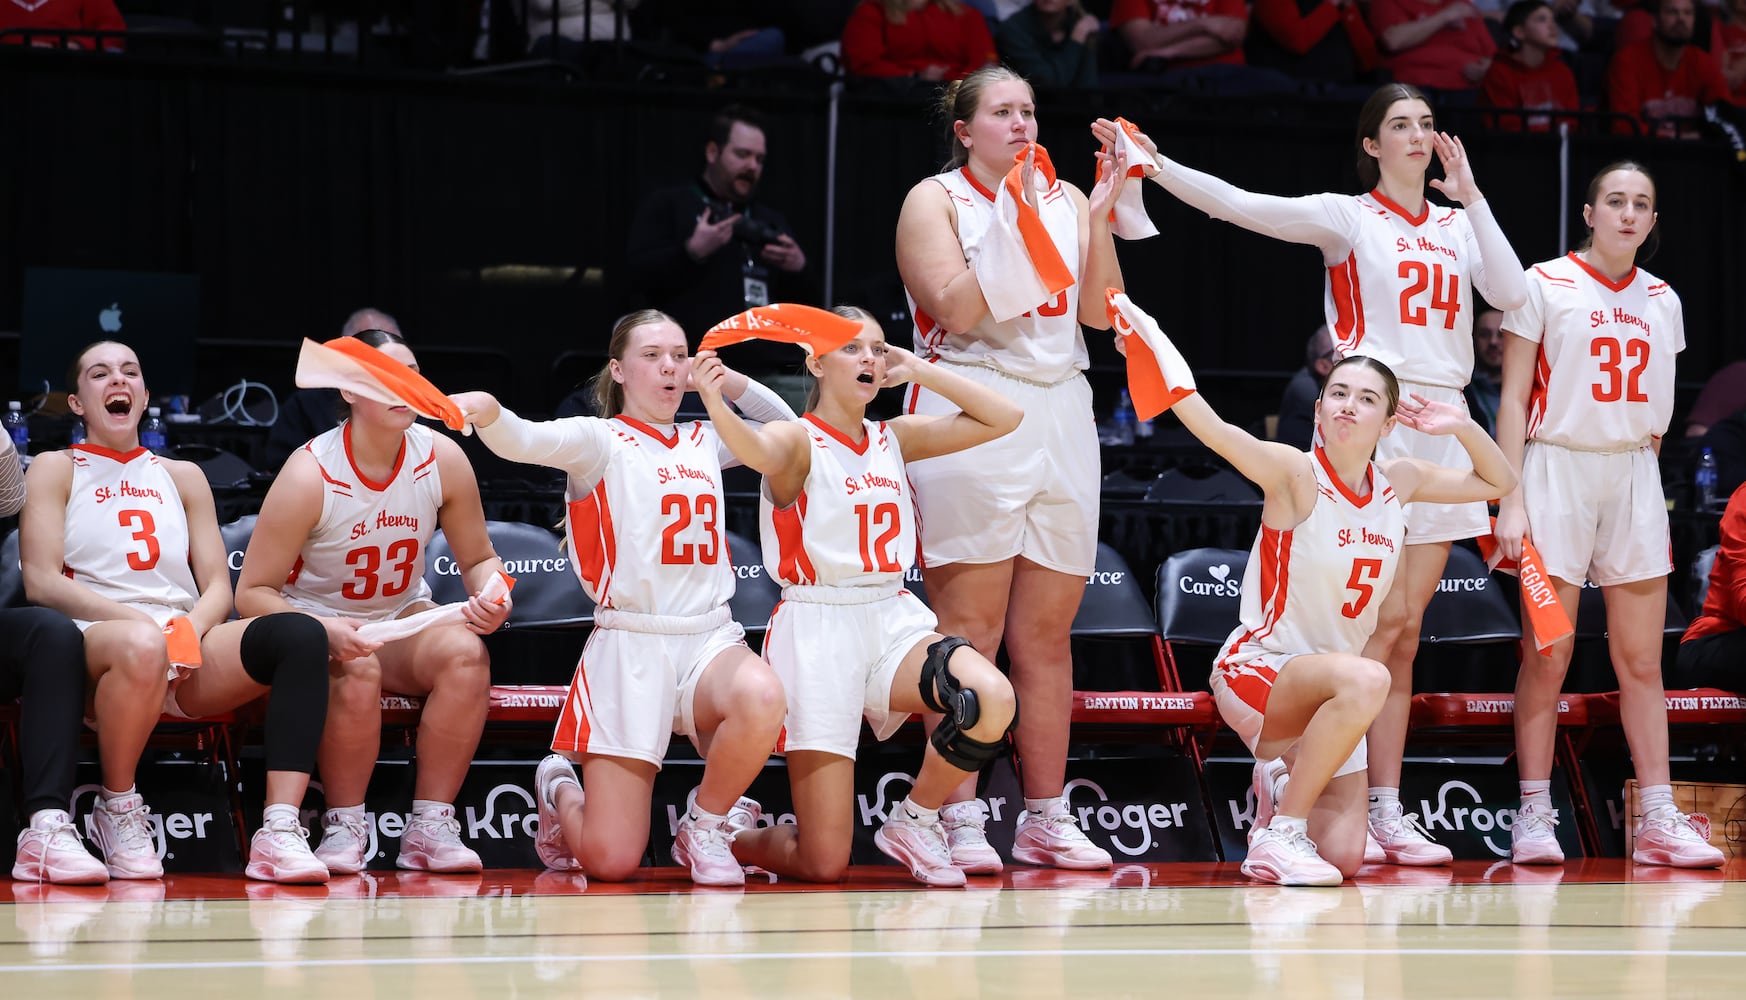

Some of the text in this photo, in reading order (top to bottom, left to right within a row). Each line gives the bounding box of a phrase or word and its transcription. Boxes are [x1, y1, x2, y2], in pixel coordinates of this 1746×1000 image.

[1398, 260, 1461, 330] 24
[1590, 307, 1650, 336] St. Henry
[1590, 336, 1650, 402] 32
[95, 480, 163, 504] St. Henry
[657, 464, 715, 489] St. Henry
[862, 472, 901, 496] Henry
[118, 510, 160, 571] 3
[351, 509, 418, 540] St. Henry
[661, 493, 719, 565] 23
[854, 502, 902, 572] 12
[1338, 528, 1355, 547] St.
[342, 538, 419, 600] 33
[1341, 558, 1383, 619] 5
[1085, 697, 1194, 710] DAYTON FLYERS
